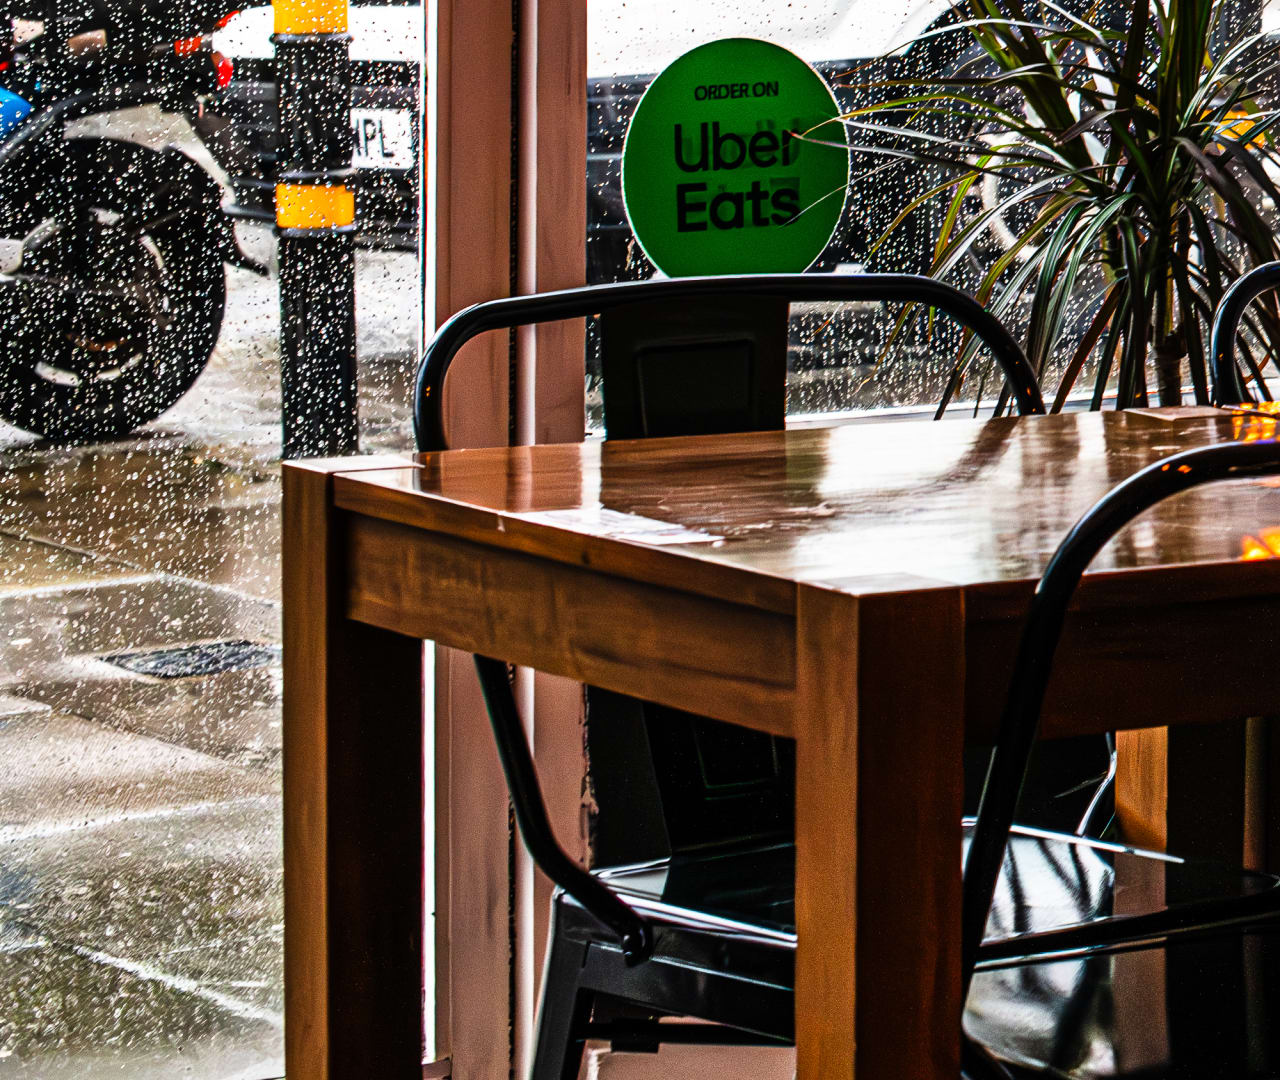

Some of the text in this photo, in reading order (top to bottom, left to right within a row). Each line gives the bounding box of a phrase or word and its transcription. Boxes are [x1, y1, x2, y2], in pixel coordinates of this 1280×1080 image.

[694, 81, 779, 101] ORDER ON
[674, 121, 799, 172] Uber
[676, 180, 800, 233] Eats
